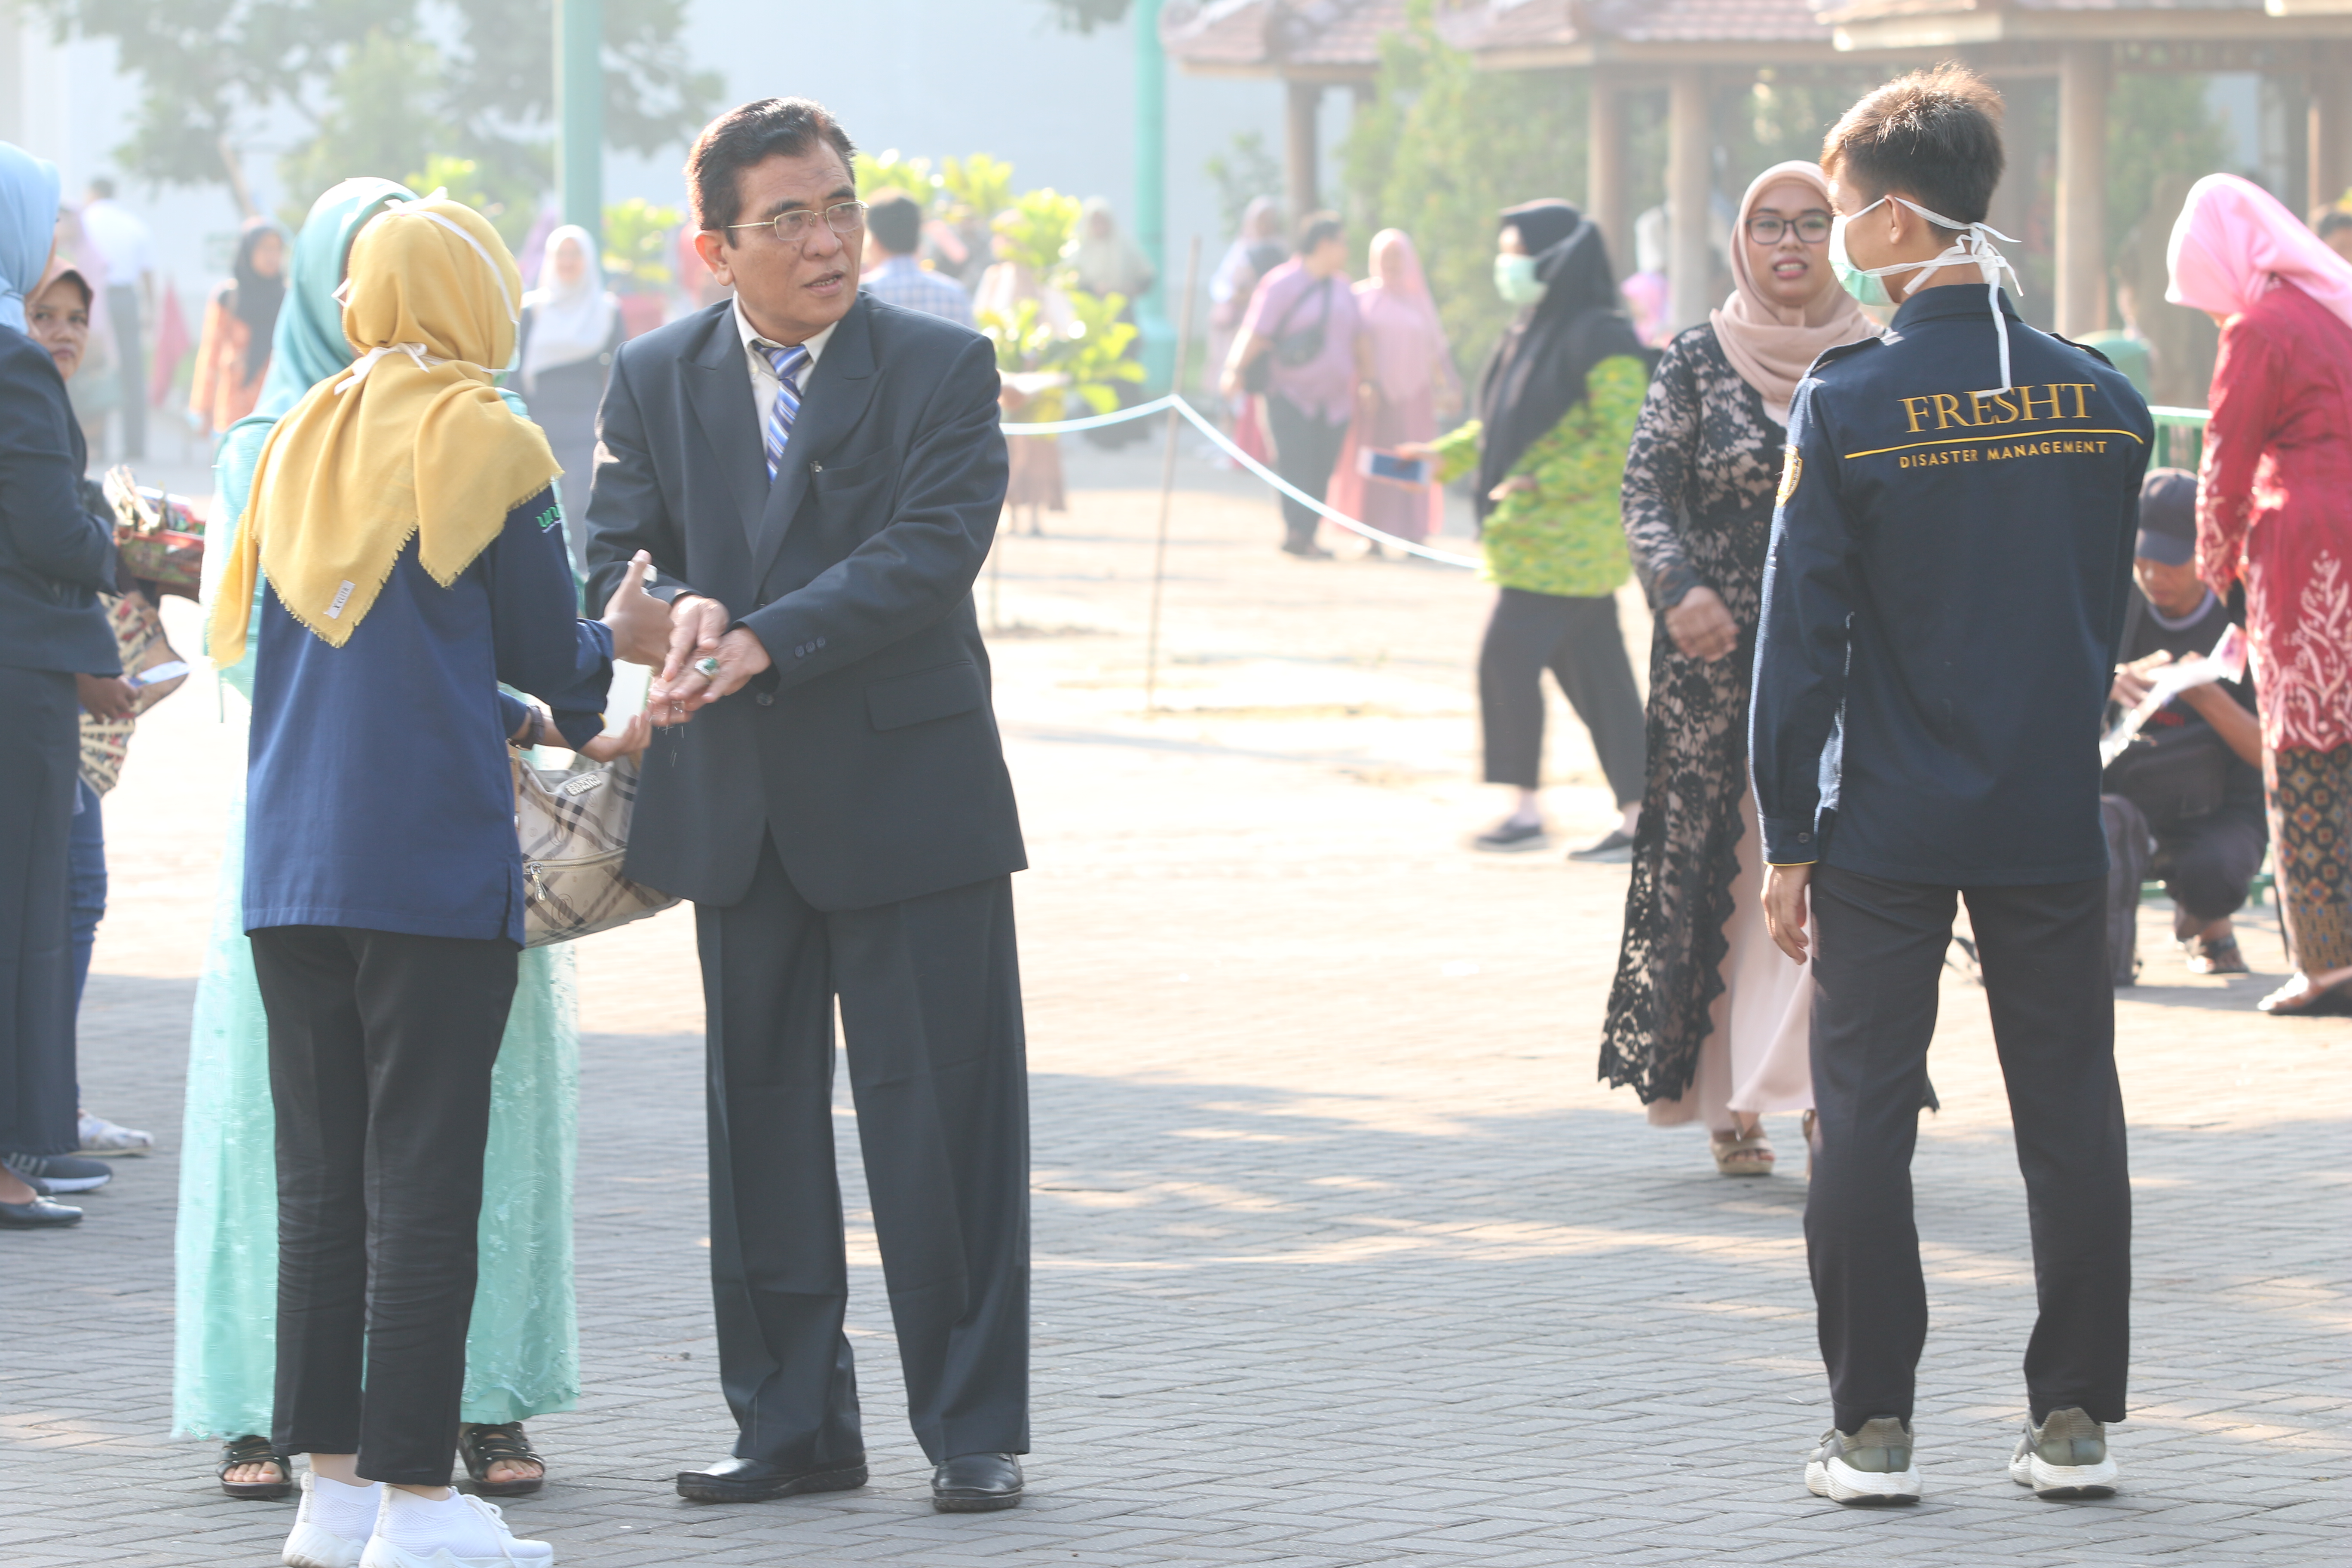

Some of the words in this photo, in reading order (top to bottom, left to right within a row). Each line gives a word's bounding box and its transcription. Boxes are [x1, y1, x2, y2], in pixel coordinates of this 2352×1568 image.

[1897, 383, 2096, 433] FRESHT
[1899, 449, 1978, 468] DISASTER
[1987, 441, 2107, 461] MANAGEMENT
